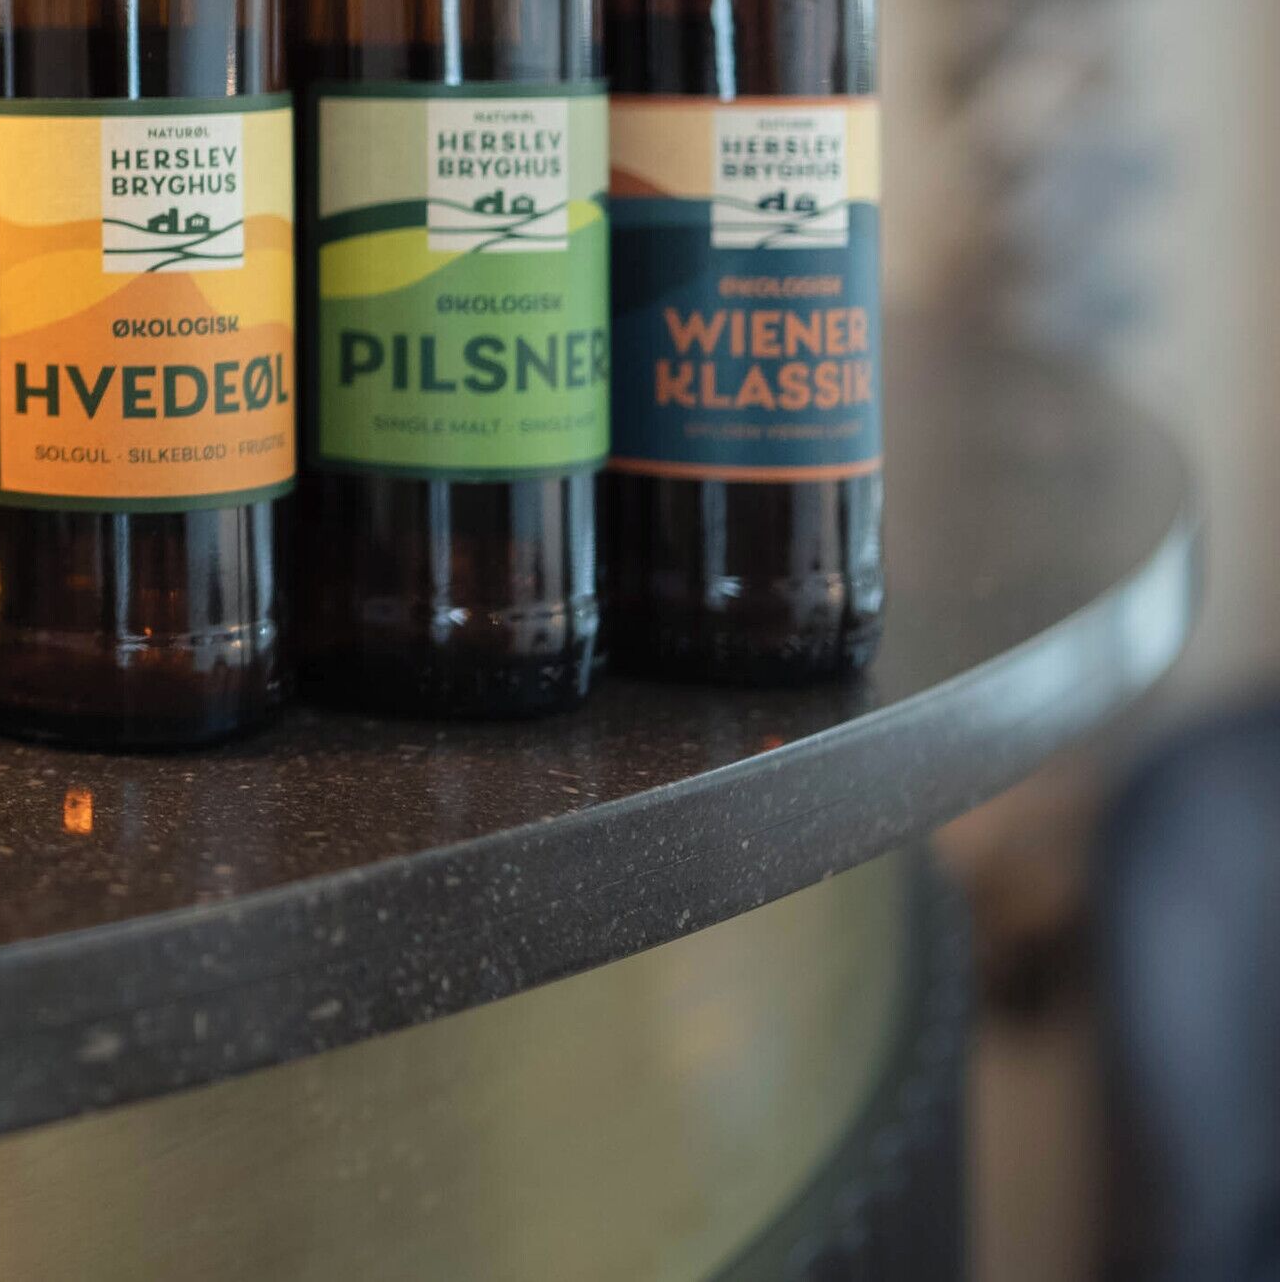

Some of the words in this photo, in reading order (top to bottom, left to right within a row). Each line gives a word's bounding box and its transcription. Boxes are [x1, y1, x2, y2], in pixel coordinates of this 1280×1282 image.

[147, 126, 210, 139] NATURØL
[437, 130, 562, 153] HERSLEV
[110, 146, 237, 171] HERSLEV
[437, 156, 562, 178] BRYGHUS
[111, 173, 237, 196] BRYGHUS
[436, 293, 561, 315] ØKOLOGISK
[112, 315, 239, 338] ØKOLOGISK
[665, 307, 867, 357] WIENER
[339, 327, 609, 394] PILSNER
[15, 353, 288, 420] HVEDEØL
[655, 359, 871, 410] KLASSIK
[448, 418, 501, 435] MALT
[35, 444, 111, 464] SOLGUL
[128, 443, 227, 464] SILKEBLØD
